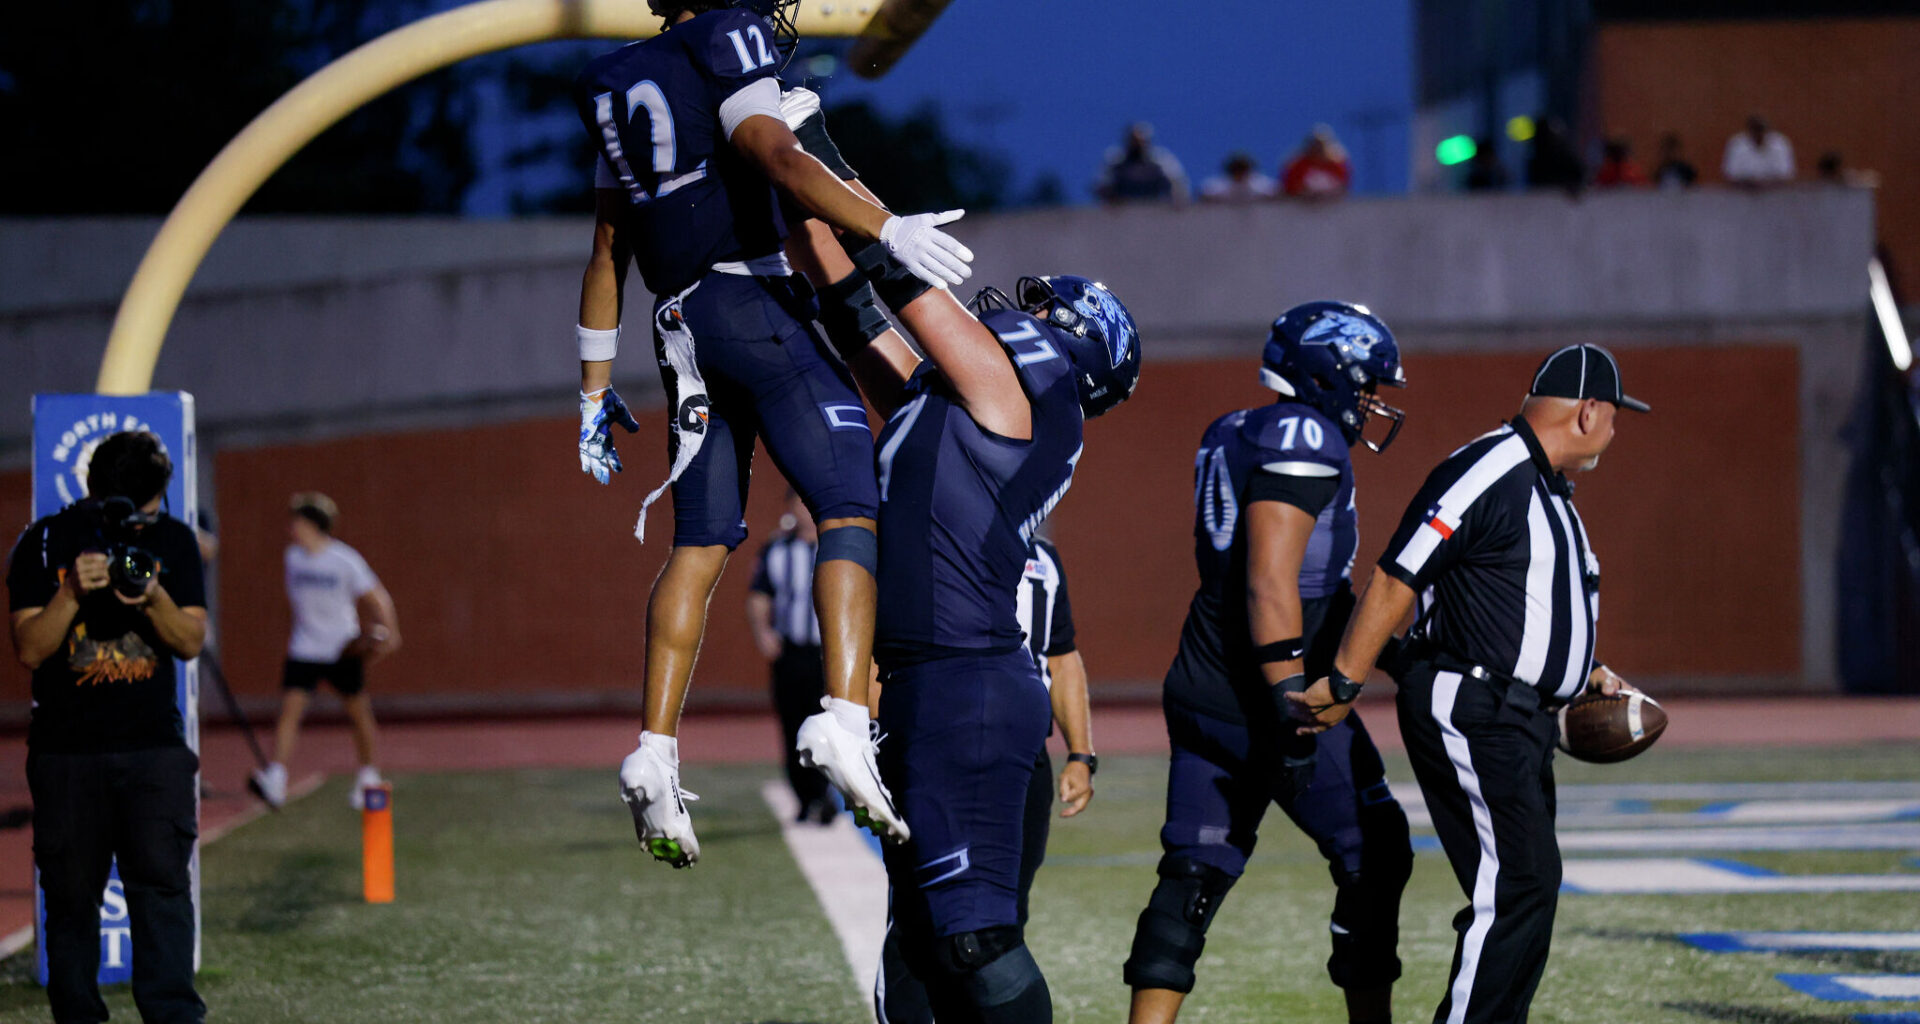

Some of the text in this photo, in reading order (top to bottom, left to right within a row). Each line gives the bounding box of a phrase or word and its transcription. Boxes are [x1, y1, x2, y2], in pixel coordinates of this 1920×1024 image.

[726, 24, 775, 74] 12
[594, 80, 707, 204] 12
[999, 320, 1060, 368] 77
[53, 412, 117, 462] NORTH
[1278, 416, 1324, 450] 70
